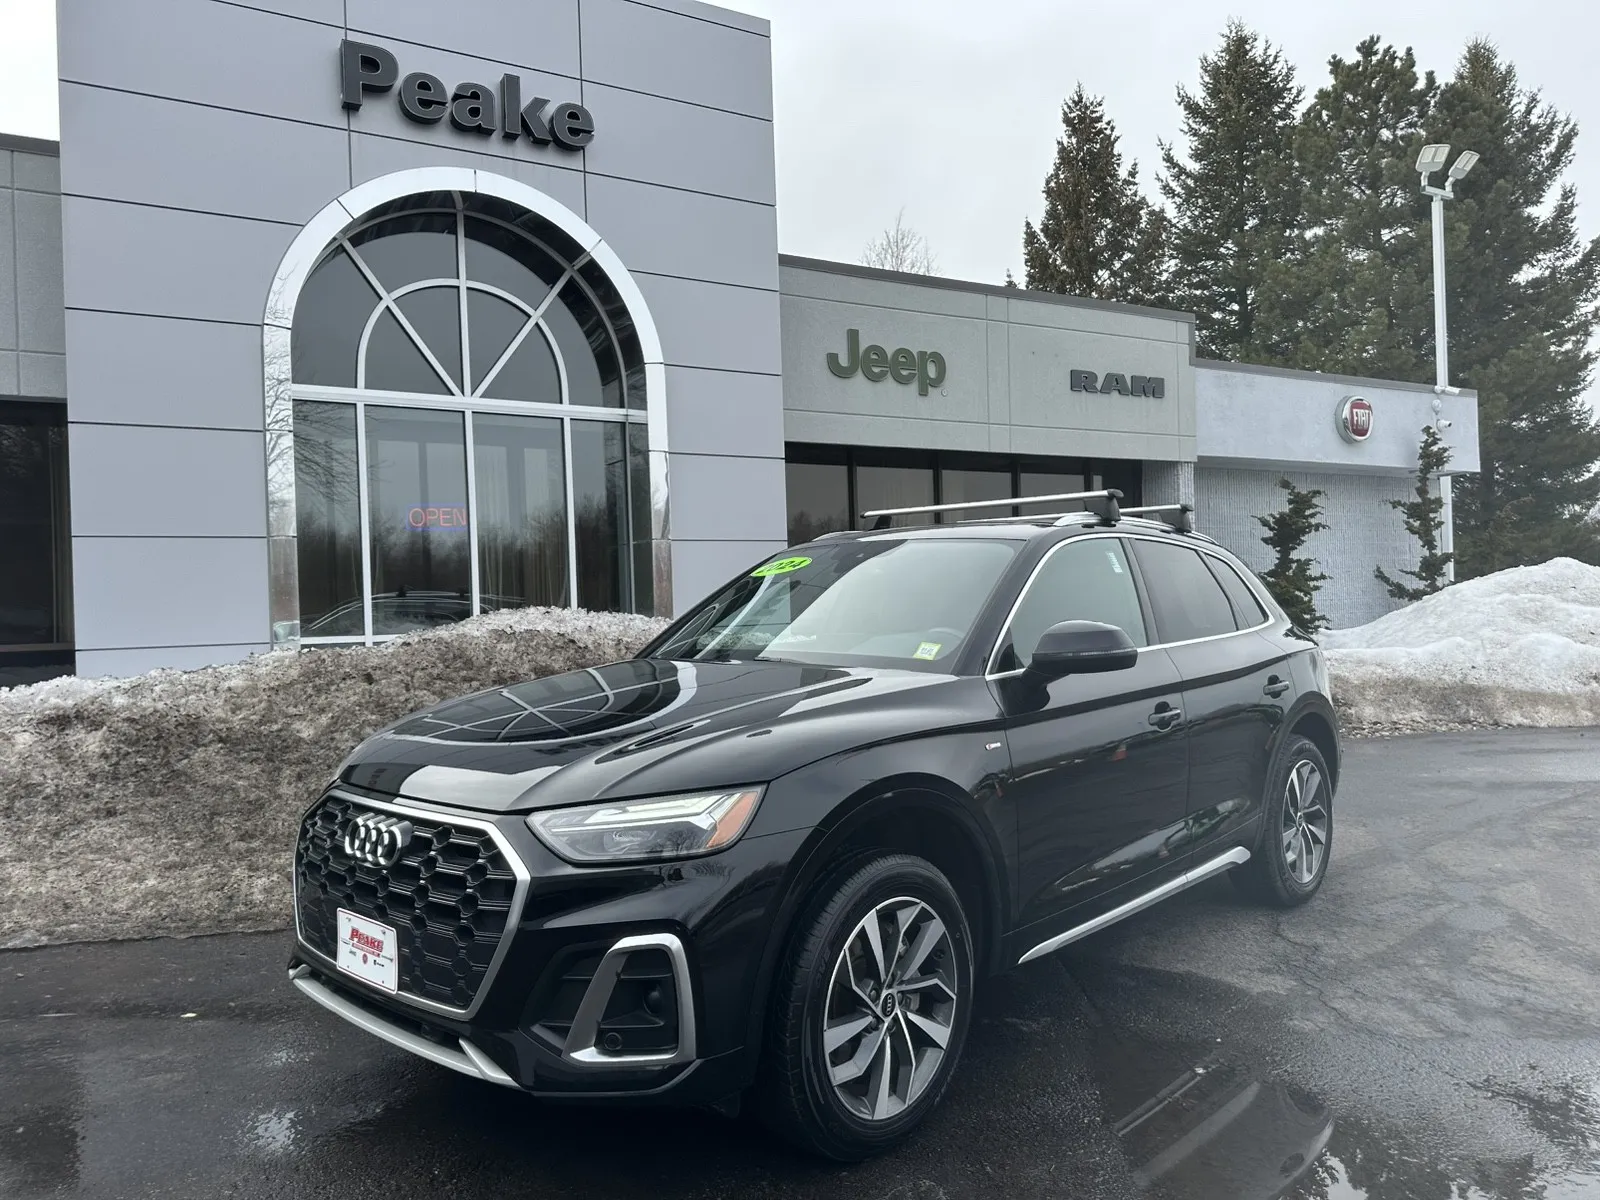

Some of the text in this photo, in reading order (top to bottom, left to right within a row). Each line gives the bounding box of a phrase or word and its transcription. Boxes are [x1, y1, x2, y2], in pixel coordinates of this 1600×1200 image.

[339, 38, 594, 150] Peake
[826, 329, 947, 397] Jeep
[1070, 369, 1165, 399] RAM
[1352, 408, 1371, 430] FIAT
[409, 507, 467, 527] OPEN
